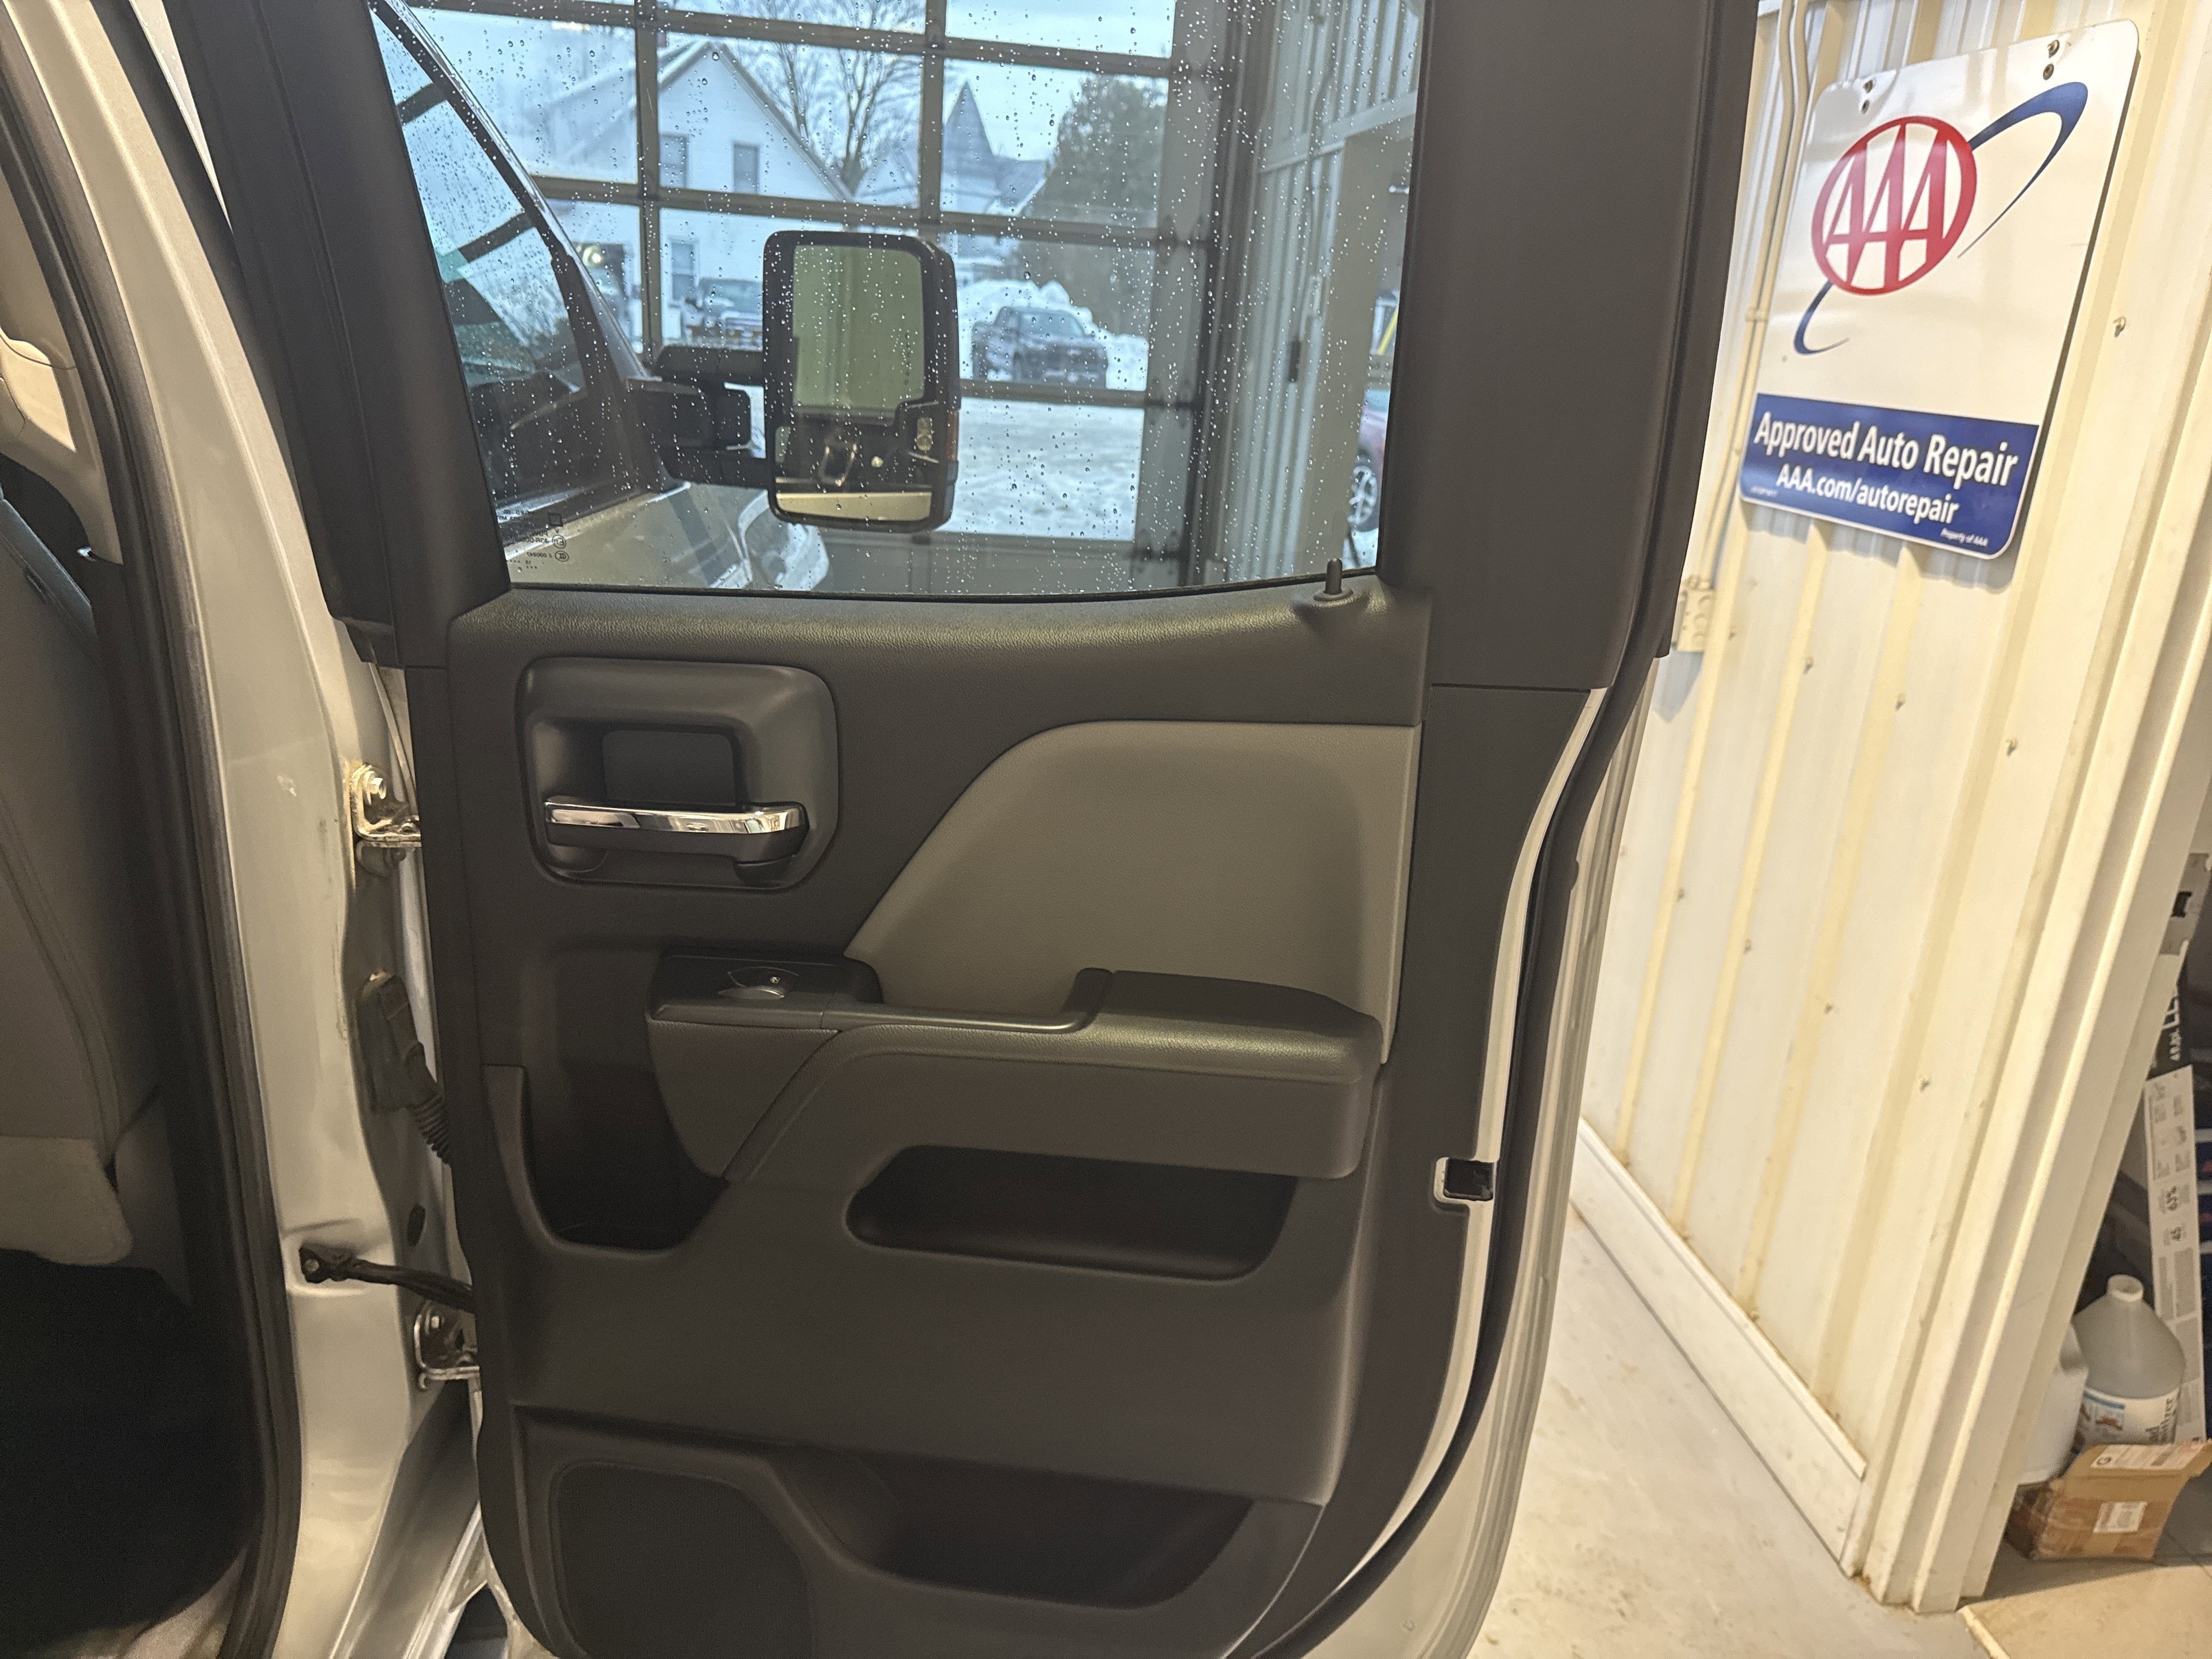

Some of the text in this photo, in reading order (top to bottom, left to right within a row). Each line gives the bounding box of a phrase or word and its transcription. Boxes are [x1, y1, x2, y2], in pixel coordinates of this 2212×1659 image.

[1813, 116, 1977, 296] AAA
[1753, 411, 2018, 490] Approved Auto Repair
[1775, 464, 1960, 524] AAA.com/autorepair
[1940, 528, 1989, 547] Property of AAA
